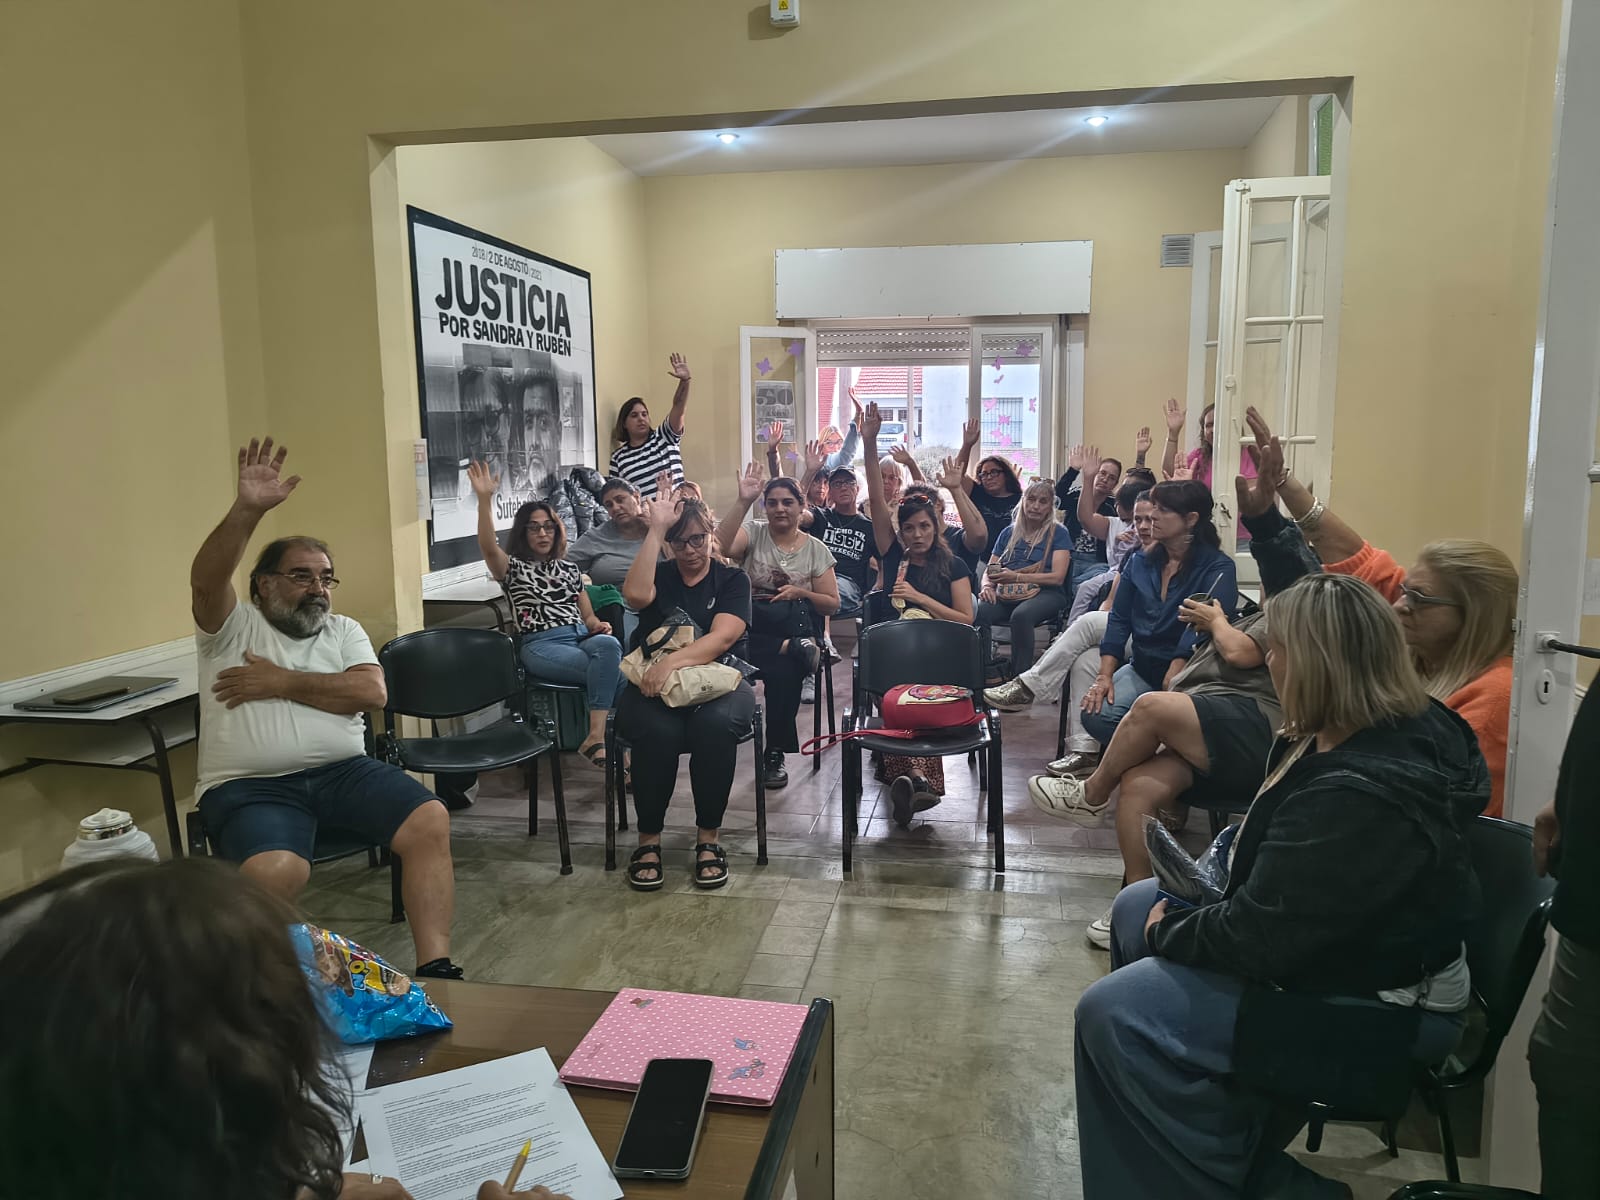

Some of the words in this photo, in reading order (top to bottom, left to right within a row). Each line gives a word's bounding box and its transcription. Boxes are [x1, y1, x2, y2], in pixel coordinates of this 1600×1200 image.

[488, 251, 493, 264] 2
[494, 253, 504, 267] DE
[504, 256, 529, 275] AGOSTO
[435, 257, 572, 338] JUSTICIA
[439, 312, 470, 338] POR
[473, 319, 525, 347] SANDRA
[526, 330, 535, 348] Y
[536, 333, 572, 356] RUBÉN
[496, 493, 526, 520] Suteb
[823, 529, 865, 552] 1967
